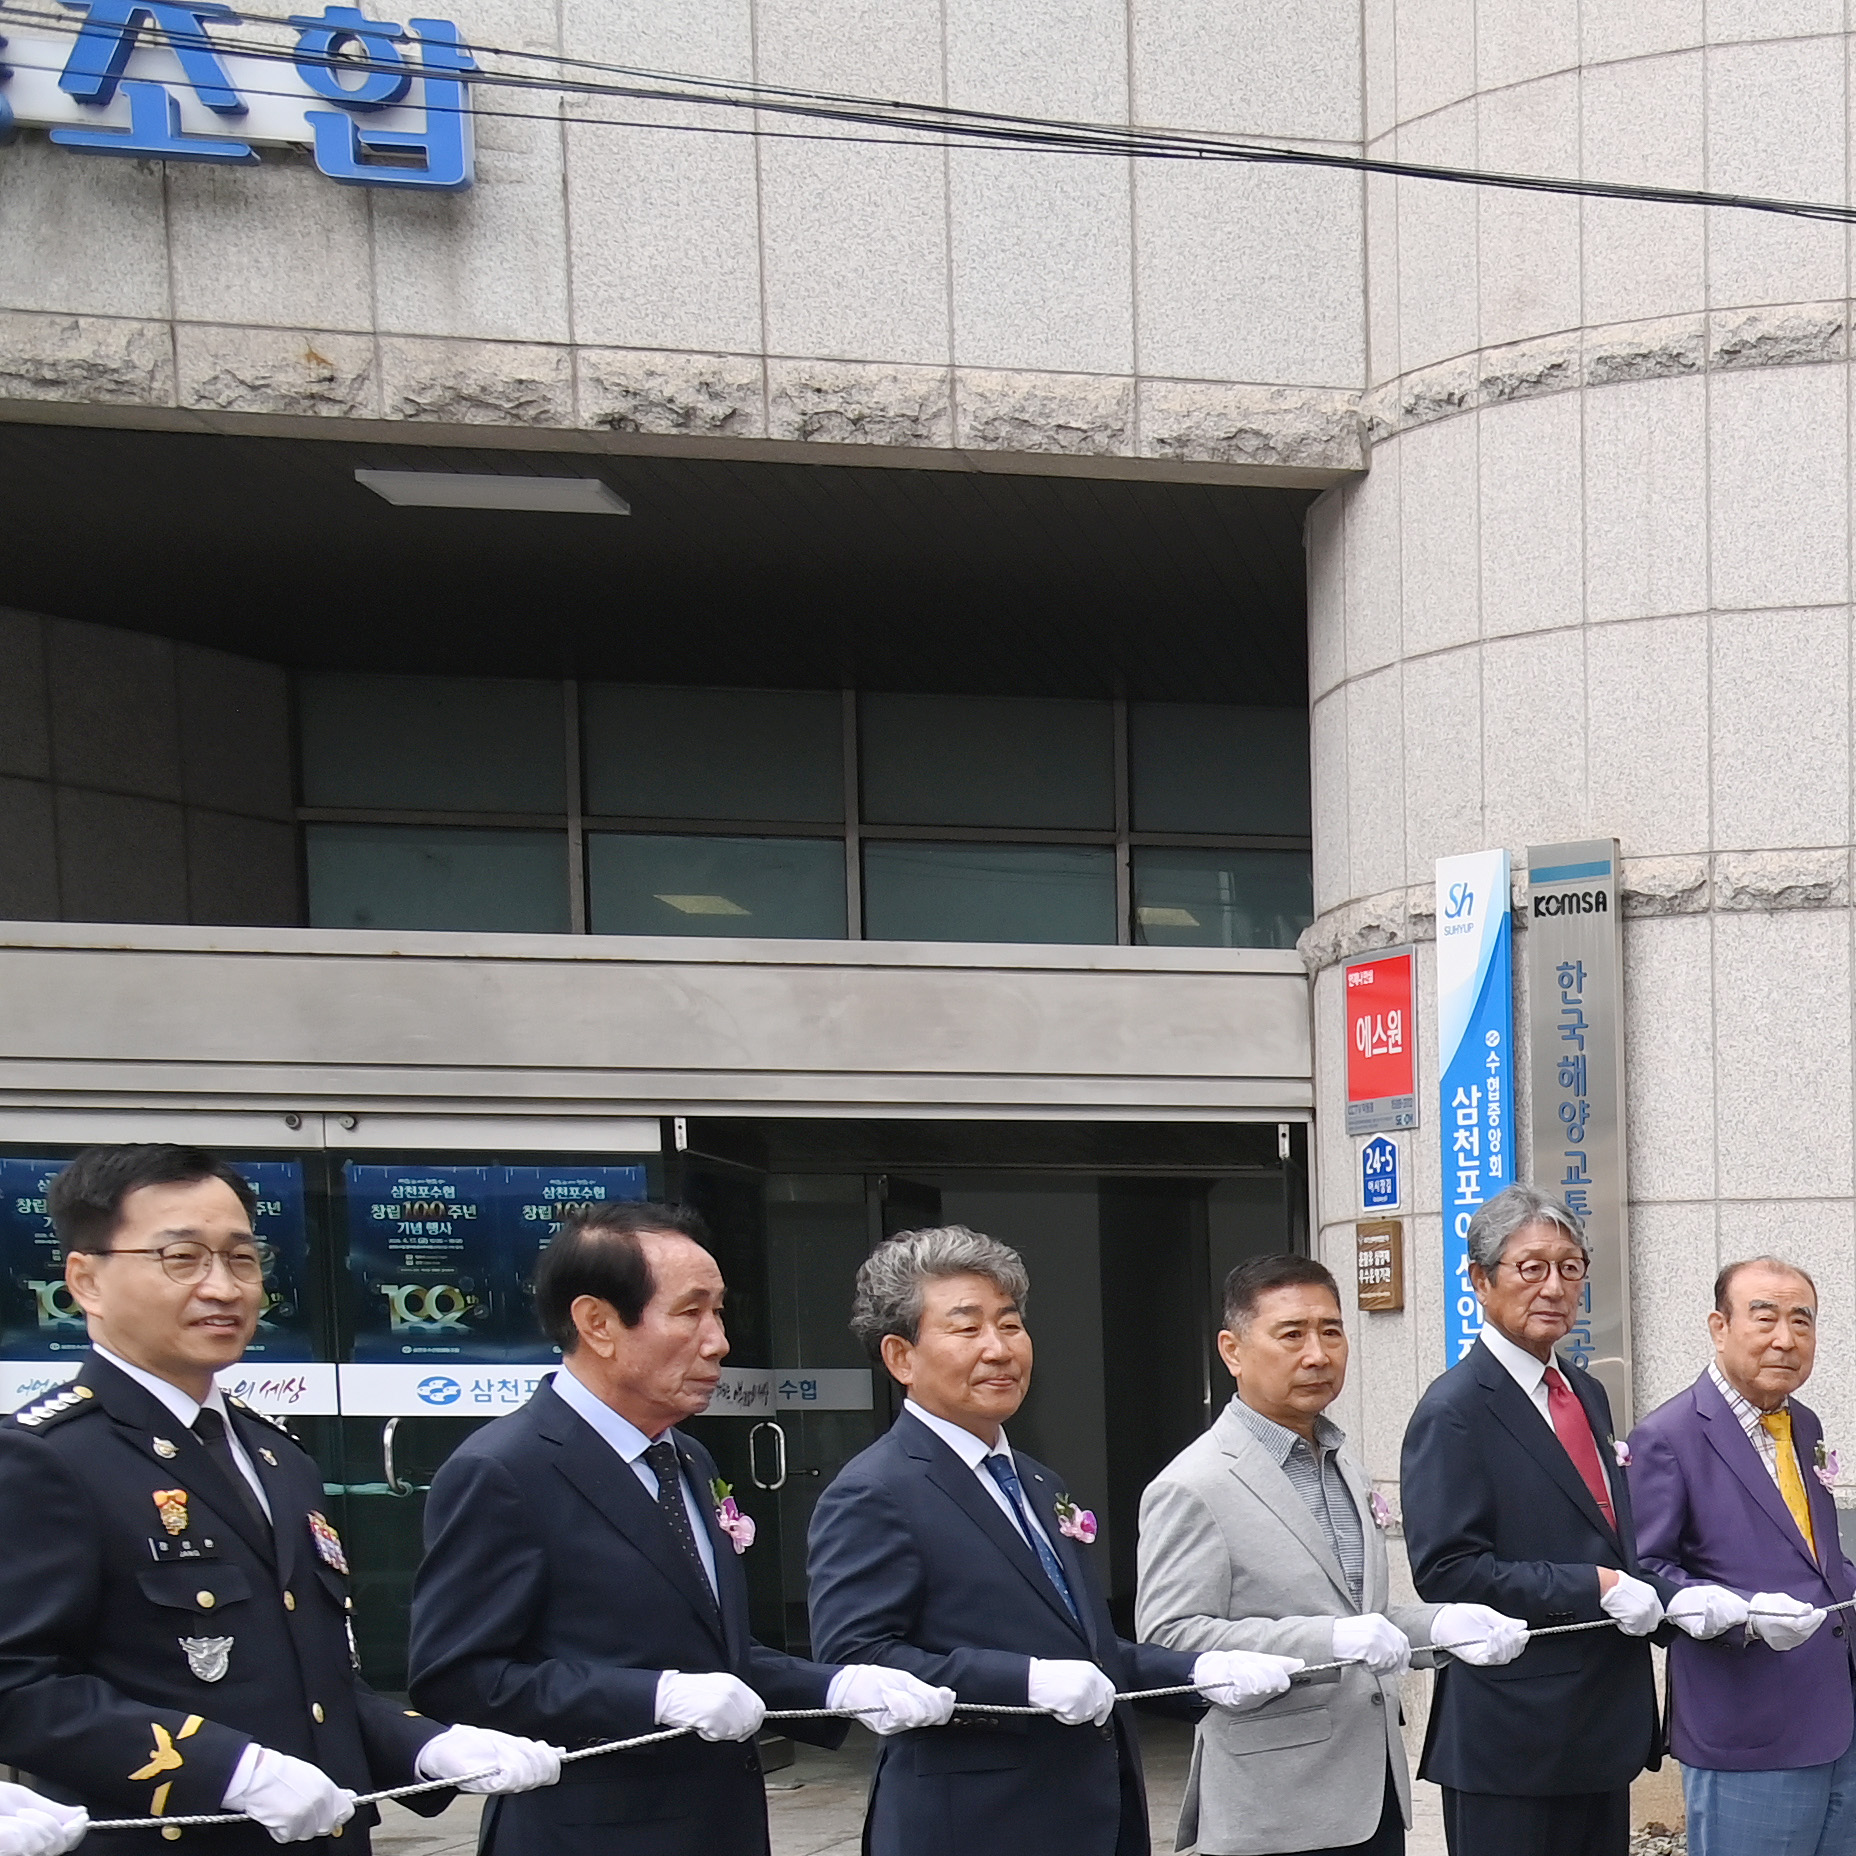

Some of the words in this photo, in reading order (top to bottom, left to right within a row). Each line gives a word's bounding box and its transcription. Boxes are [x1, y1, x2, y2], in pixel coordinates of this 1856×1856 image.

[0, 0, 477, 191] 조합
[1444, 882, 1474, 919] Sh
[1534, 890, 1607, 918] KOMSA
[1444, 923, 1474, 936] SUHYUP
[1356, 1009, 1402, 1058] 에스원
[1486, 1051, 1502, 1178] 수협중앙회
[1366, 1145, 1393, 1174] 24-5
[397, 1221, 422, 1235] 기념
[426, 1221, 452, 1235] 행사
[778, 1380, 816, 1400] 수협
